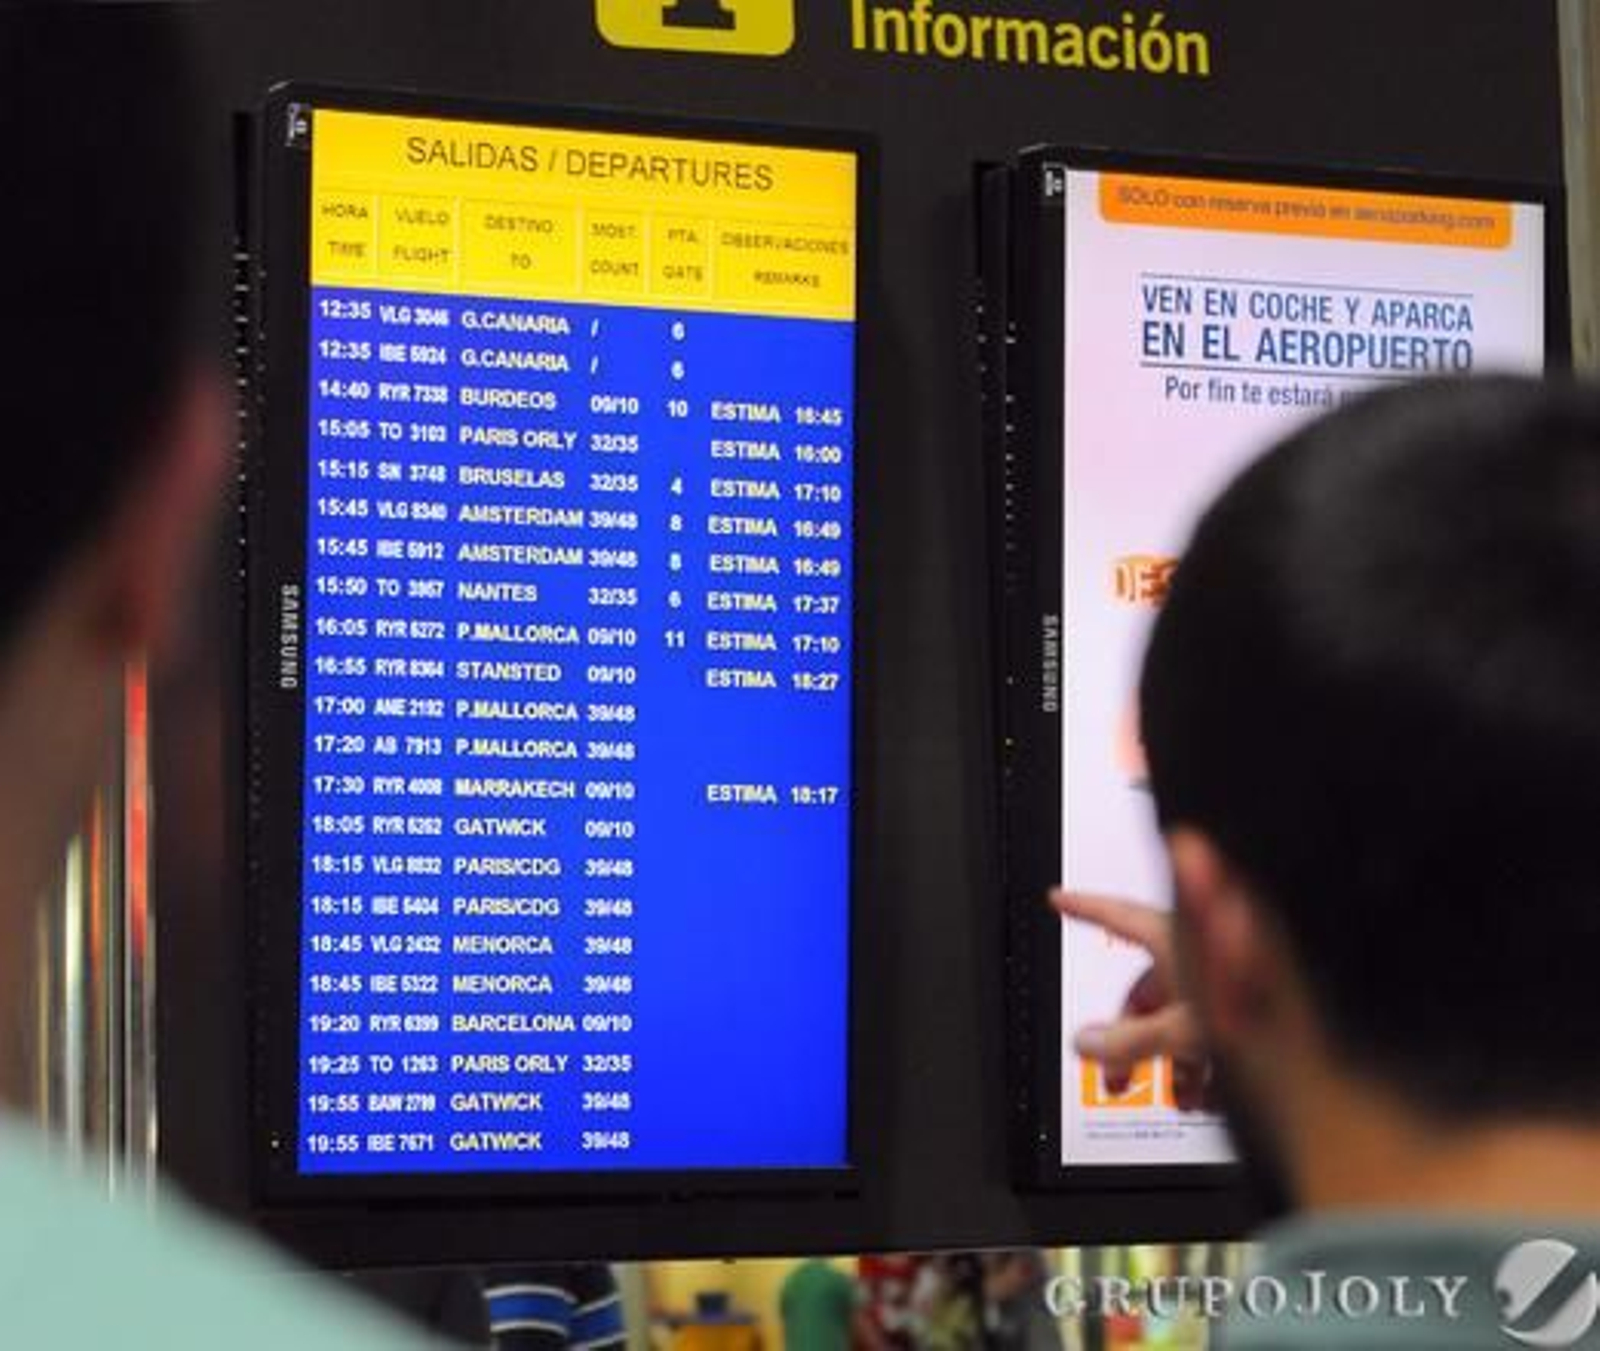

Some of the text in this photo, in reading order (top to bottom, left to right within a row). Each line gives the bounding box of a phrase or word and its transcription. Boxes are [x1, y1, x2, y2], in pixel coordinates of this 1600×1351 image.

[850, 0, 1210, 75] Información
[406, 136, 538, 173] SALIDAS
[566, 149, 775, 191] DEPARTURES
[322, 203, 368, 219] HORA
[395, 208, 449, 225] VUELO
[485, 214, 554, 233] DESTINO
[721, 232, 850, 255] OBSERVACIONES
[328, 240, 820, 288] TIME FLIGHT TO COUNT GATE REMARKS
[319, 300, 684, 340] 12:35 VLG G.CANARIA 6
[1142, 284, 1474, 332] VEN EN COCHE Y APARCA
[319, 339, 684, 379] 12:35 IBE G.CANARIA 6
[1143, 320, 1474, 371] EN EL AEROPUERTO
[319, 379, 371, 399] 14:40
[378, 382, 410, 401] RYR
[460, 387, 557, 410] BURDEOS
[591, 395, 639, 414] 09/10
[667, 400, 688, 417] 10
[711, 401, 781, 422] ESTIMA
[1164, 375, 1201, 400] Por
[1208, 378, 1235, 403] fin
[1242, 381, 1263, 405] te
[318, 419, 370, 438] 15:05
[378, 422, 402, 440] TO
[460, 426, 518, 447] PARIS
[523, 430, 577, 450] ORLY
[591, 434, 639, 453] 32/35
[711, 440, 781, 460] ESTIMA
[318, 459, 369, 479] 15:15
[459, 466, 565, 489] BRUSELAS
[589, 473, 638, 492] 32/35
[671, 478, 682, 494] 4
[711, 478, 780, 499] ESTIMA
[794, 484, 841, 502] 17:10
[318, 498, 368, 517] 15:45
[377, 501, 408, 519] VLG
[458, 505, 584, 527] AMSTERDAM
[589, 511, 638, 529] 39/48
[670, 514, 682, 531] 8
[708, 515, 777, 536] ESTIMA
[318, 538, 368, 556] 15:45
[376, 540, 404, 558] IBE
[457, 543, 583, 565] AMSTERDAM
[589, 549, 638, 568] 39/48
[670, 553, 681, 570] 8
[710, 554, 780, 574] ESTIMA
[317, 576, 839, 613] 15:50 TO NANTES 32/35 6 ESTIMA 17:37
[281, 584, 298, 688] SAMSUNG
[316, 617, 367, 636] 16:05
[376, 619, 407, 637] RYR
[457, 622, 579, 644] P.MALLORCA
[588, 628, 637, 646] 09/10
[665, 631, 684, 647] 11
[707, 631, 777, 650] ESTIMA
[793, 635, 840, 653] 17:10
[375, 658, 407, 676] RYR
[456, 661, 561, 681] STANSTED
[587, 665, 636, 684] 09/10
[706, 669, 776, 687] ESTIMA
[314, 696, 365, 715] 17:00
[456, 700, 579, 721] P.MALLORCA
[587, 704, 635, 722] 39/48
[314, 735, 365, 753] 17:20
[456, 738, 578, 758] P.MALLORCA
[586, 742, 635, 760] 39/48
[313, 776, 365, 794] 17:30
[373, 776, 405, 794] RYR
[454, 778, 575, 798] MARRAKECH
[585, 781, 635, 799] 09/10
[707, 784, 777, 803] ESTIMA
[313, 815, 634, 838] 18:05 RYR GATWICK 09/10
[312, 855, 633, 877] 18:15 VLG PARIS/CDG 39/48
[312, 896, 632, 917] 18:15 IBE PARIS/CDG 39/48
[311, 935, 632, 954] 18:45 VLG MENORCA 39/48
[310, 975, 362, 992] 18:45
[370, 975, 397, 992] IBE
[453, 975, 552, 993] MENORCA
[584, 975, 632, 993] 39/48
[309, 1014, 632, 1032] 19:20 RYR BARCELONA 09/10
[309, 1055, 631, 1074] 19:25 TO PARIS ORLY 32/35
[309, 1094, 359, 1112] 19:55
[450, 1093, 542, 1111] GATWICK
[583, 1092, 630, 1110] 39/48
[308, 1135, 359, 1152] 19:55
[368, 1134, 395, 1151] IBE
[450, 1132, 541, 1151] GATWICK
[583, 1132, 629, 1149] 39/48
